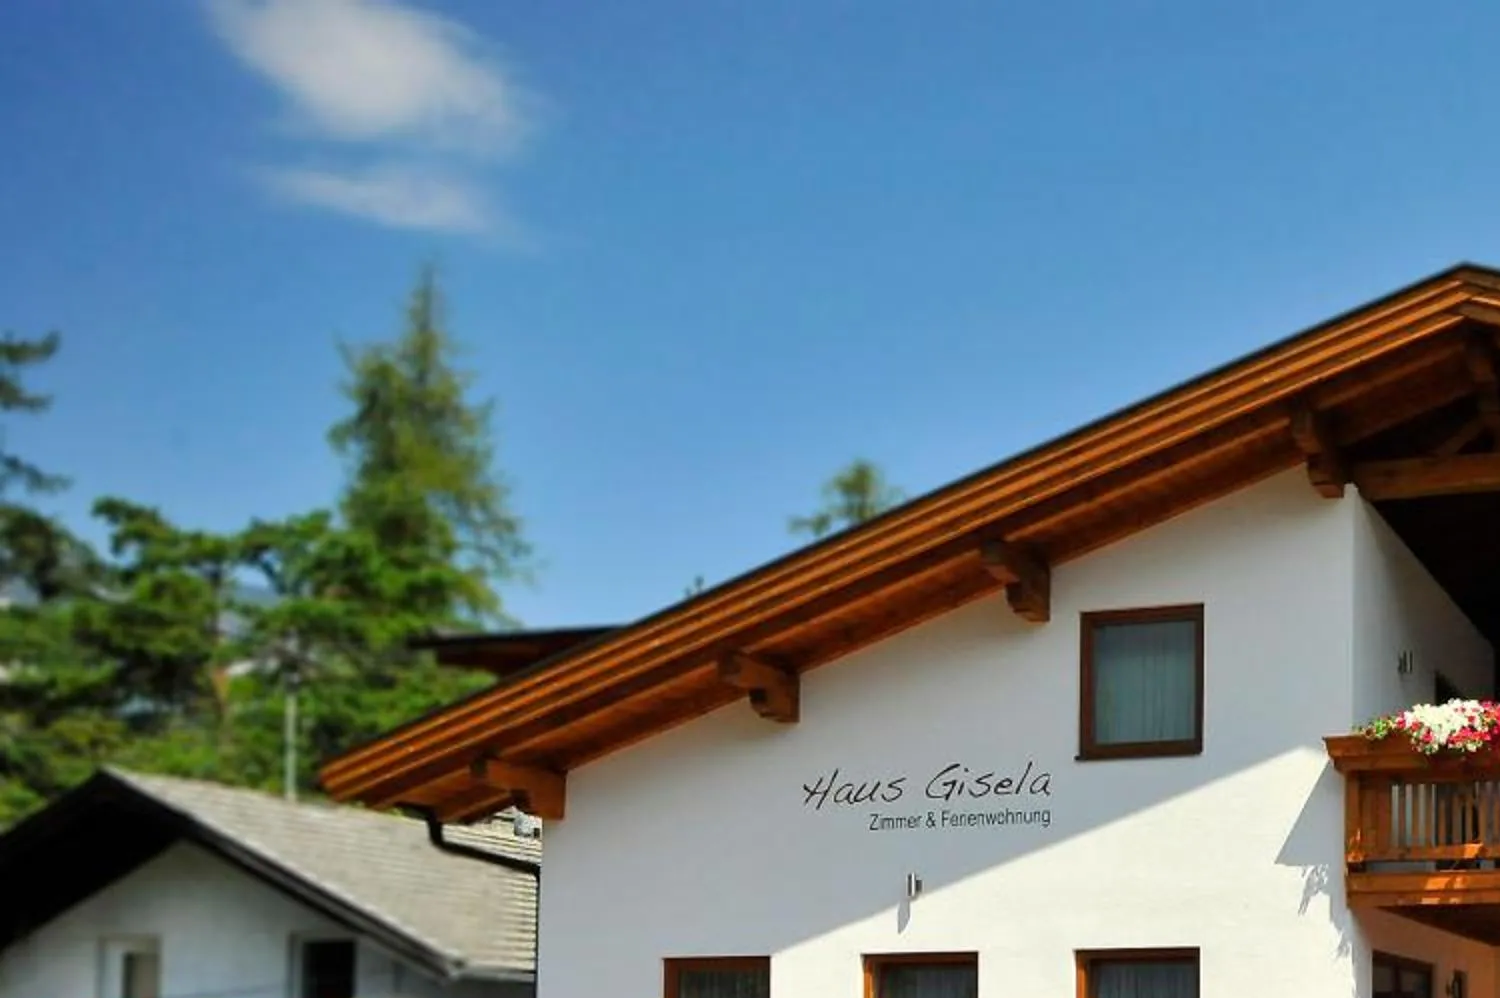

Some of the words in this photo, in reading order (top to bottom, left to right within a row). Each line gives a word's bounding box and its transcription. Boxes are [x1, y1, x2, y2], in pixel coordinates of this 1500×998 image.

[803, 768, 907, 810] Haus
[925, 761, 1051, 801] Gisela
[869, 813, 922, 831] Zimmer
[925, 811, 936, 828] &
[941, 808, 1051, 828] Ferienwohnung
